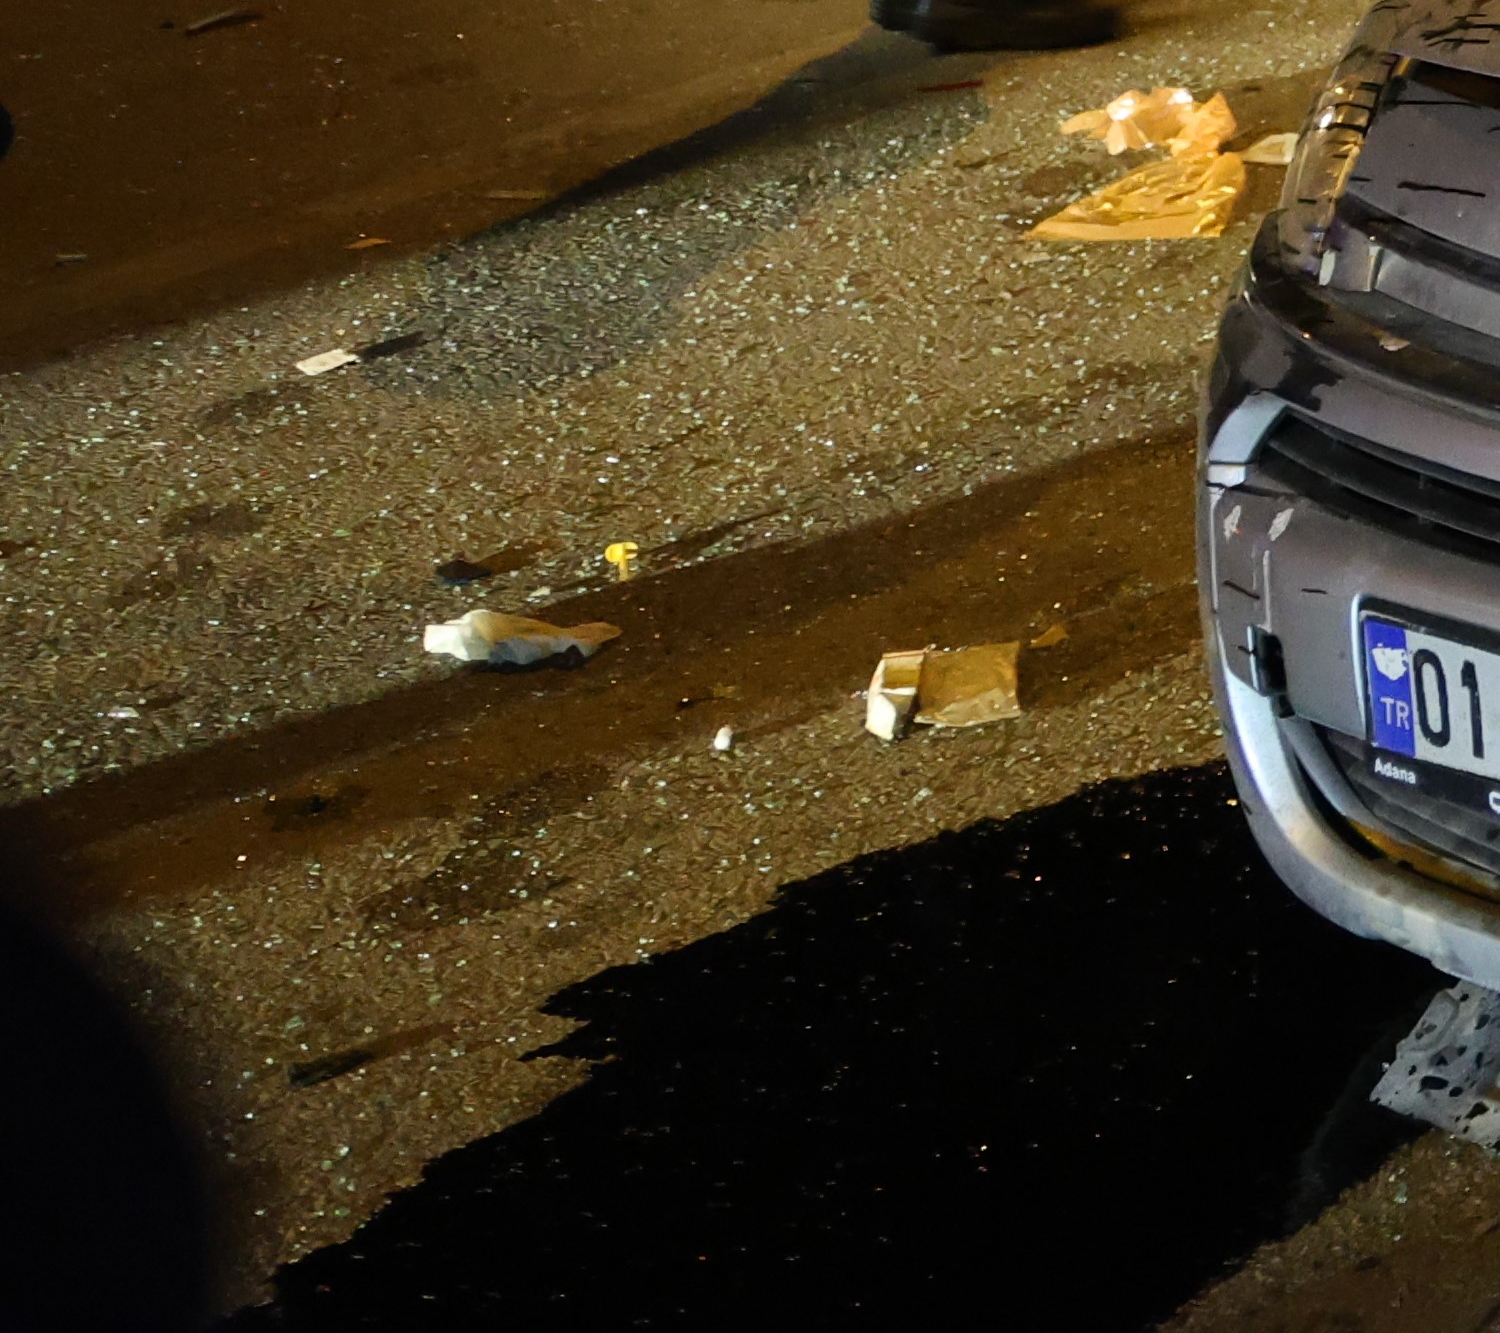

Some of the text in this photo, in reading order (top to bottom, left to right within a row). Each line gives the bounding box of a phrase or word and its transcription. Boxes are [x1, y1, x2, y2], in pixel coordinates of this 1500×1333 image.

[1380, 696, 1411, 732] TR
[1412, 648, 1485, 759] 01
[1374, 758, 1417, 784] Adana
